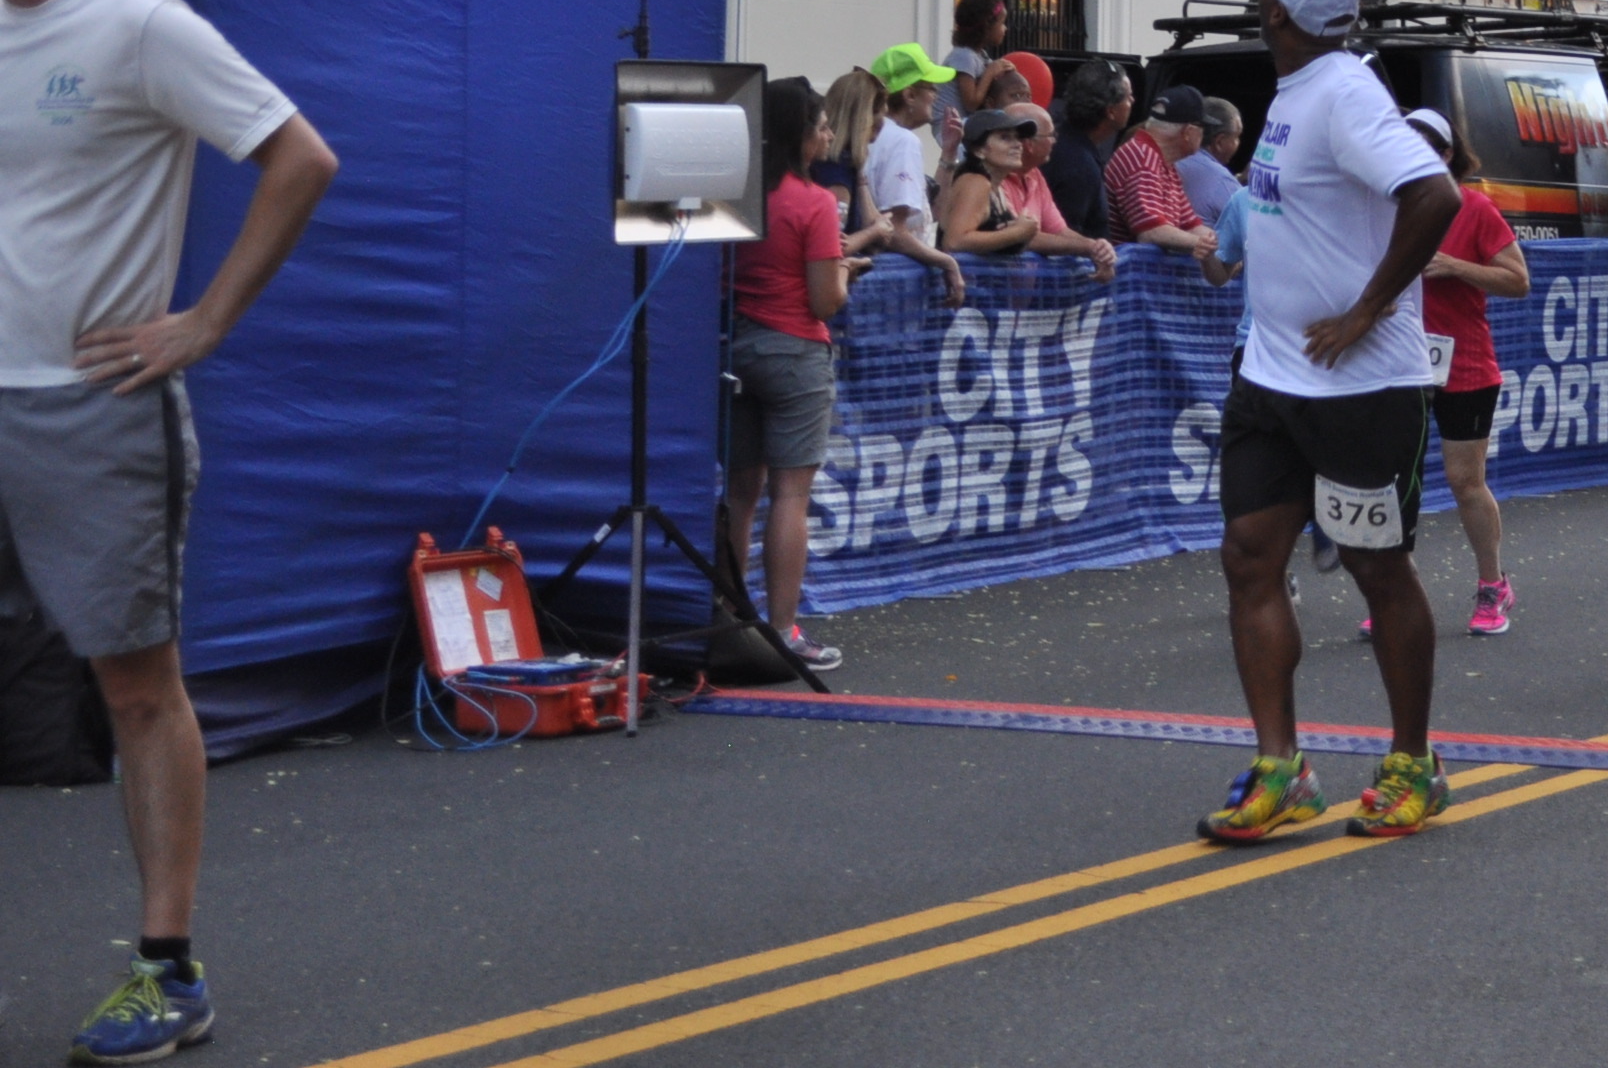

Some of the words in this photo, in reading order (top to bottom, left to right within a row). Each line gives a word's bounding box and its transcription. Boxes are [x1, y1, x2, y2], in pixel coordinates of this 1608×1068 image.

[938, 296, 1114, 422] CITY
[805, 410, 1094, 557] SPORTS
[1327, 494, 1387, 527] 376
